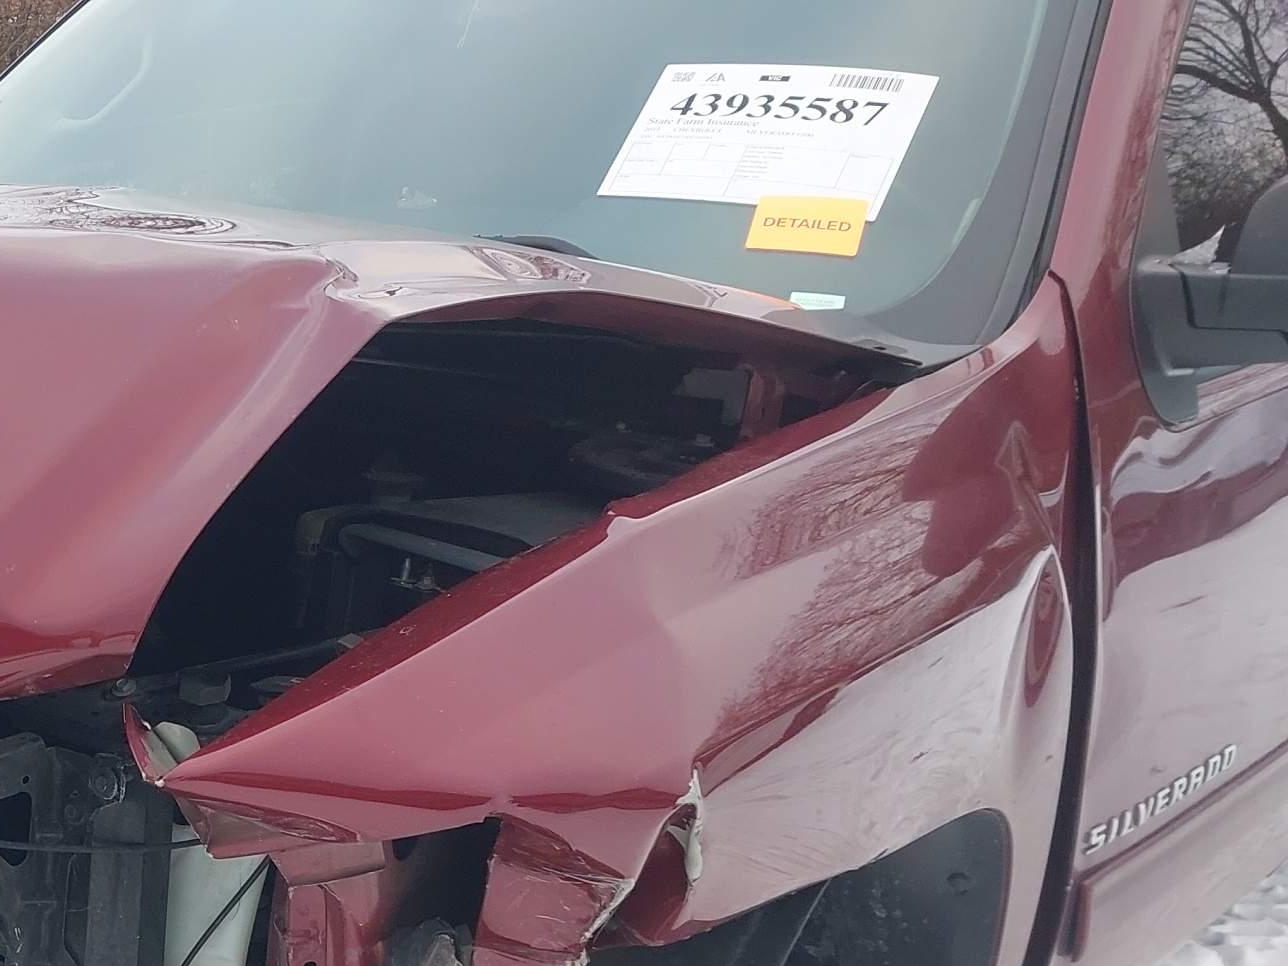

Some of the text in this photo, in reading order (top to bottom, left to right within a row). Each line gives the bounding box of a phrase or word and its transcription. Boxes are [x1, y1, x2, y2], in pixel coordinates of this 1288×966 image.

[669, 93, 890, 126] 43935587
[762, 216, 852, 233] DETAILED
[1084, 744, 1238, 856] SILVERADO
